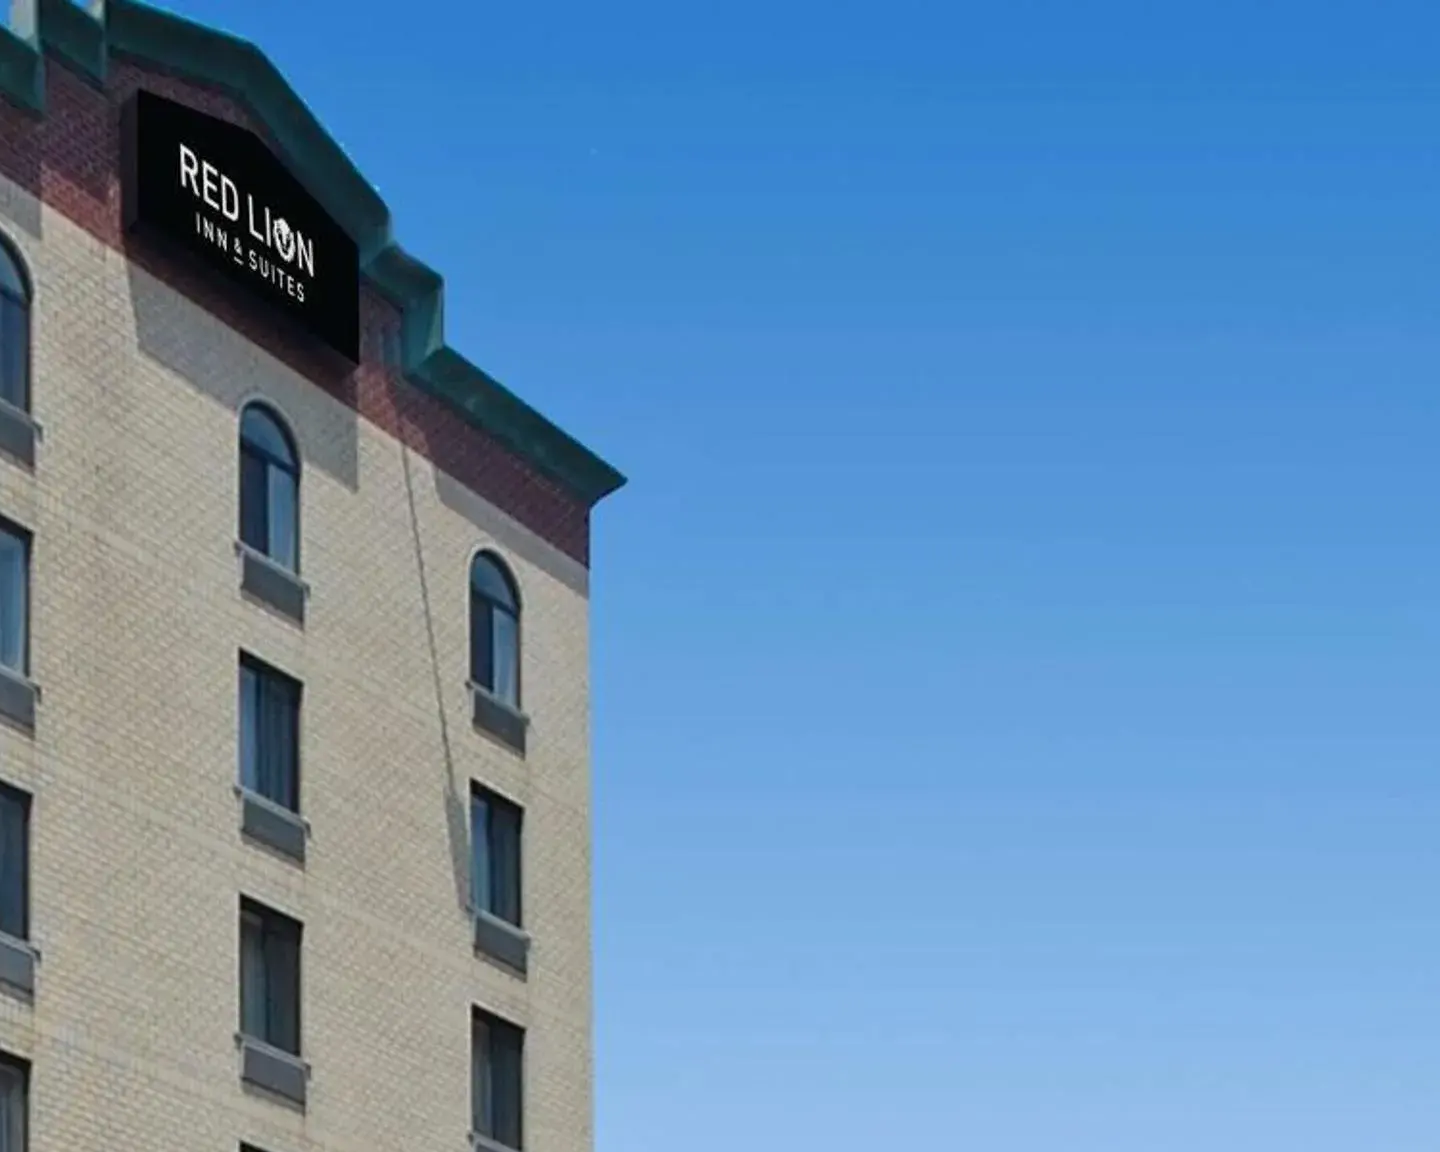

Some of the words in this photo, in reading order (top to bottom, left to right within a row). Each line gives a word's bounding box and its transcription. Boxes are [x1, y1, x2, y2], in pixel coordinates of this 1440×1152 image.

[180, 143, 239, 222] RED
[247, 193, 315, 277] LION
[196, 212, 228, 252] INN
[234, 237, 244, 266] &
[249, 250, 305, 303] SUITES
